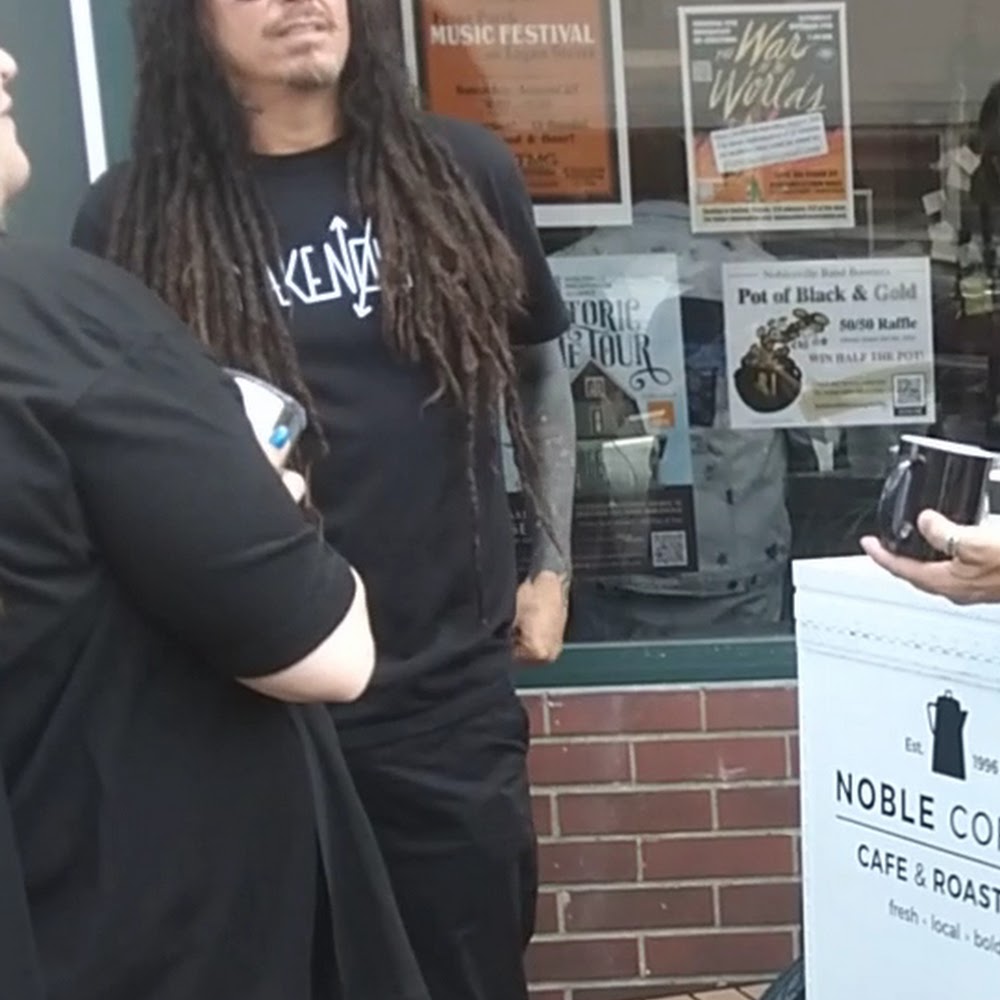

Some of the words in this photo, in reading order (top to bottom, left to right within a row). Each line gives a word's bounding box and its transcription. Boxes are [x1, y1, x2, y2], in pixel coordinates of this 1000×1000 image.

[430, 23, 496, 46] MUSIC
[499, 23, 596, 45] FESTIVAL
[734, 19, 812, 67] War
[708, 67, 827, 120] Worlds
[737, 286, 768, 305] Pot
[773, 286, 791, 304] of
[796, 284, 846, 304] Black
[852, 284, 868, 302] &
[873, 282, 917, 301] Gold
[839, 317, 874, 332] 50/50
[878, 315, 918, 331] Raffle
[809, 352, 833, 363] WIN
[835, 351, 868, 363] HALF
[870, 351, 894, 361] THE
[904, 736, 924, 755] Est.
[972, 753, 1000, 775] 1996
[836, 769, 936, 830] NOBLE
[857, 843, 908, 882] CAFE
[913, 861, 927, 889] &
[888, 899, 920, 926] fresh
[930, 913, 961, 941] local
